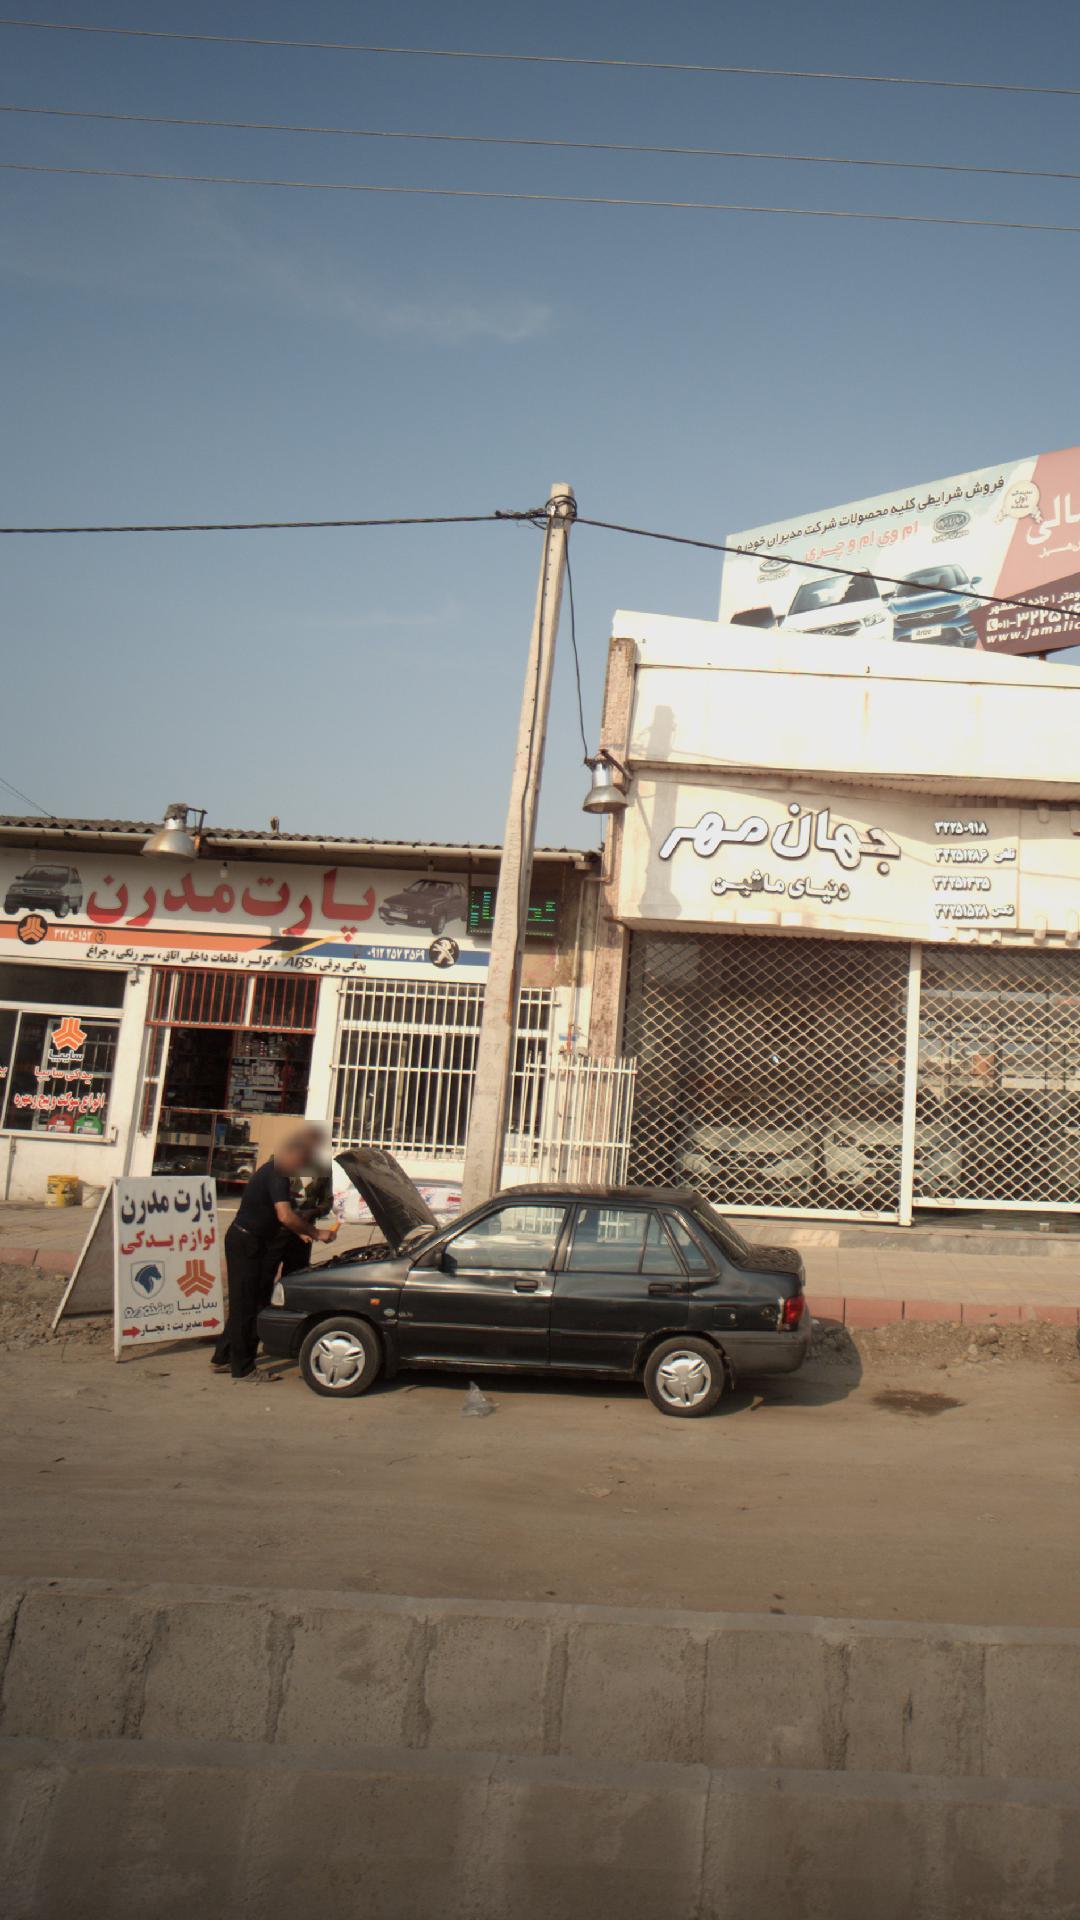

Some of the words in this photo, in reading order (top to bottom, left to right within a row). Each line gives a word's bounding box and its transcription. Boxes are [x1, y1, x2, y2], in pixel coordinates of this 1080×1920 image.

[965, 476, 1004, 499] فروش
[890, 497, 916, 517] کلیه
[918, 486, 963, 510] شرایطی
[804, 517, 837, 535] شرکت
[839, 507, 889, 527] محصولات
[767, 528, 803, 548] مدیران
[658, 811, 770, 861] مهر
[771, 802, 901, 875] جهان
[711, 869, 785, 897] ماشین
[787, 876, 850, 904] دنیای
[86, 873, 236, 927] مدرن
[241, 867, 376, 944] پارت
[181, 951, 208, 963] داخلی
[210, 952, 239, 964] قطعات
[246, 955, 273, 967] کولر
[319, 958, 341, 973] برقی
[342, 960, 367, 974] یدکی
[48, 1049, 84, 1063] سایپا
[34, 1066, 65, 1082] سایپا
[65, 1068, 94, 1085] یدکی
[121, 1189, 170, 1225] مدرن
[174, 1182, 215, 1223] پارت
[121, 1229, 175, 1256] یدکی
[178, 1226, 216, 1252] لوازم
[177, 1297, 218, 1316] سایپا
